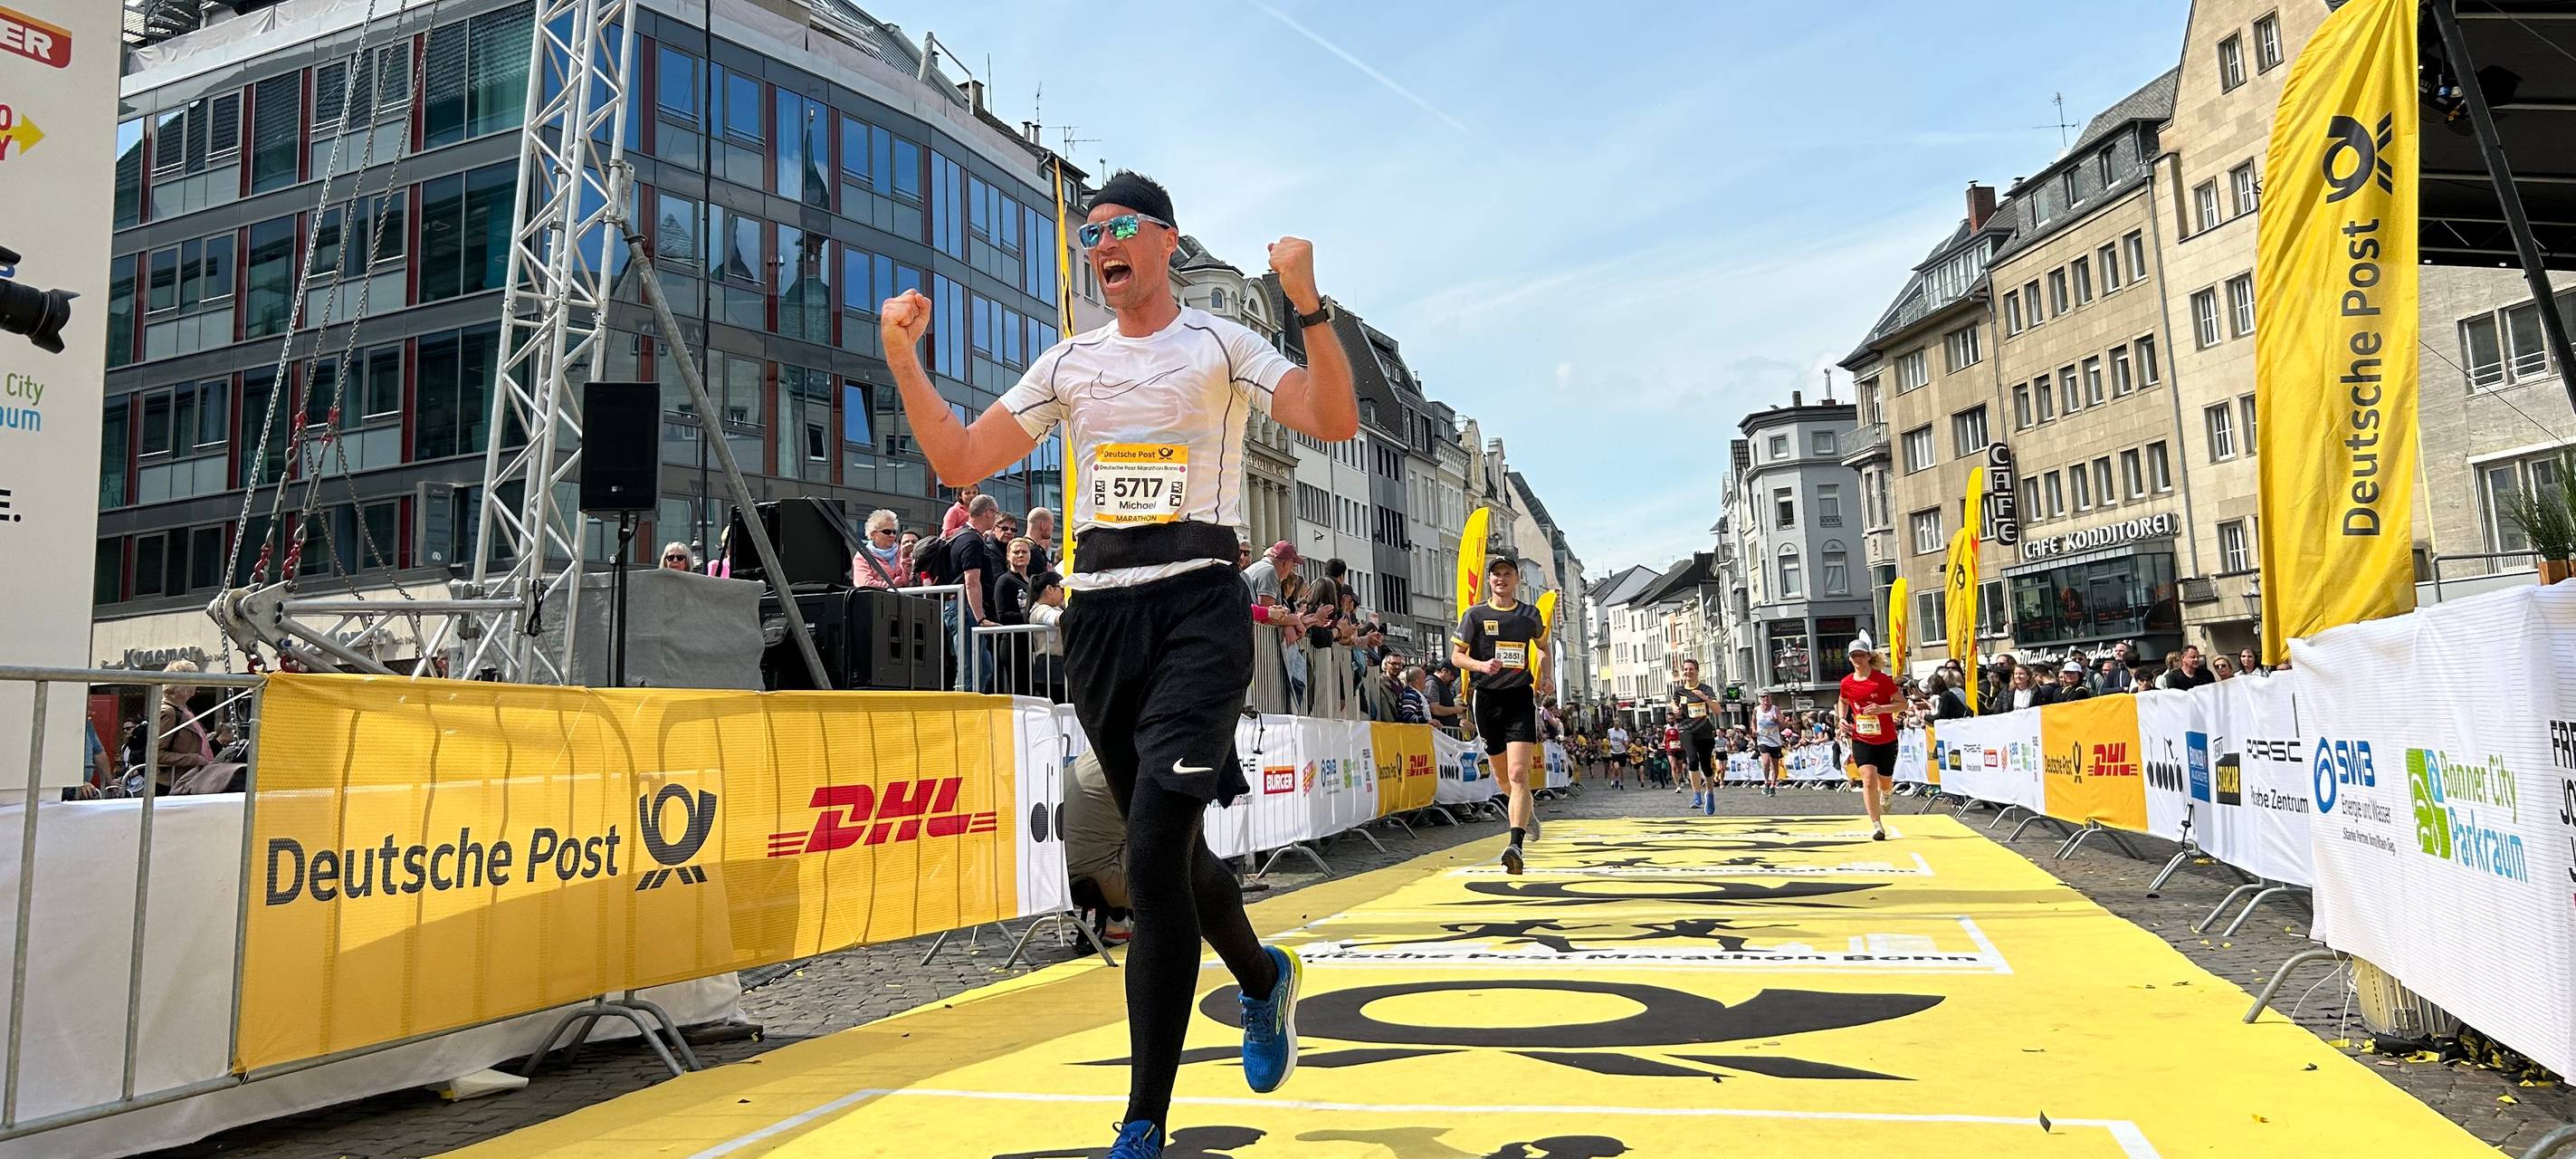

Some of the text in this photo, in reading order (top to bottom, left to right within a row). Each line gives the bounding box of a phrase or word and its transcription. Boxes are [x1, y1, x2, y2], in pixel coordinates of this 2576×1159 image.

[6, 372, 44, 406] City
[2341, 217, 2381, 536] Deutsche Post
[1103, 450, 1137, 458] Deutsche
[1113, 477, 1163, 497] 5717
[1990, 445, 2018, 542] CAFE
[1115, 514, 1158, 522] MARATHON
[1119, 501, 1157, 510] Michael
[2024, 513, 2171, 560] CAFE KONDITOREI
[1503, 652, 1520, 660] 2851
[2093, 742, 2131, 776] DHL
[2335, 740, 2376, 788] SWB
[1266, 770, 1293, 791] BÜRGER
[2218, 766, 2239, 793] STARCAR
[2439, 751, 2517, 824] Bonner City
[802, 776, 976, 854] DHL
[2270, 789, 2310, 814] Zentrum
[2448, 806, 2529, 884] Parkraum
[265, 824, 622, 906] Deutsche Post
